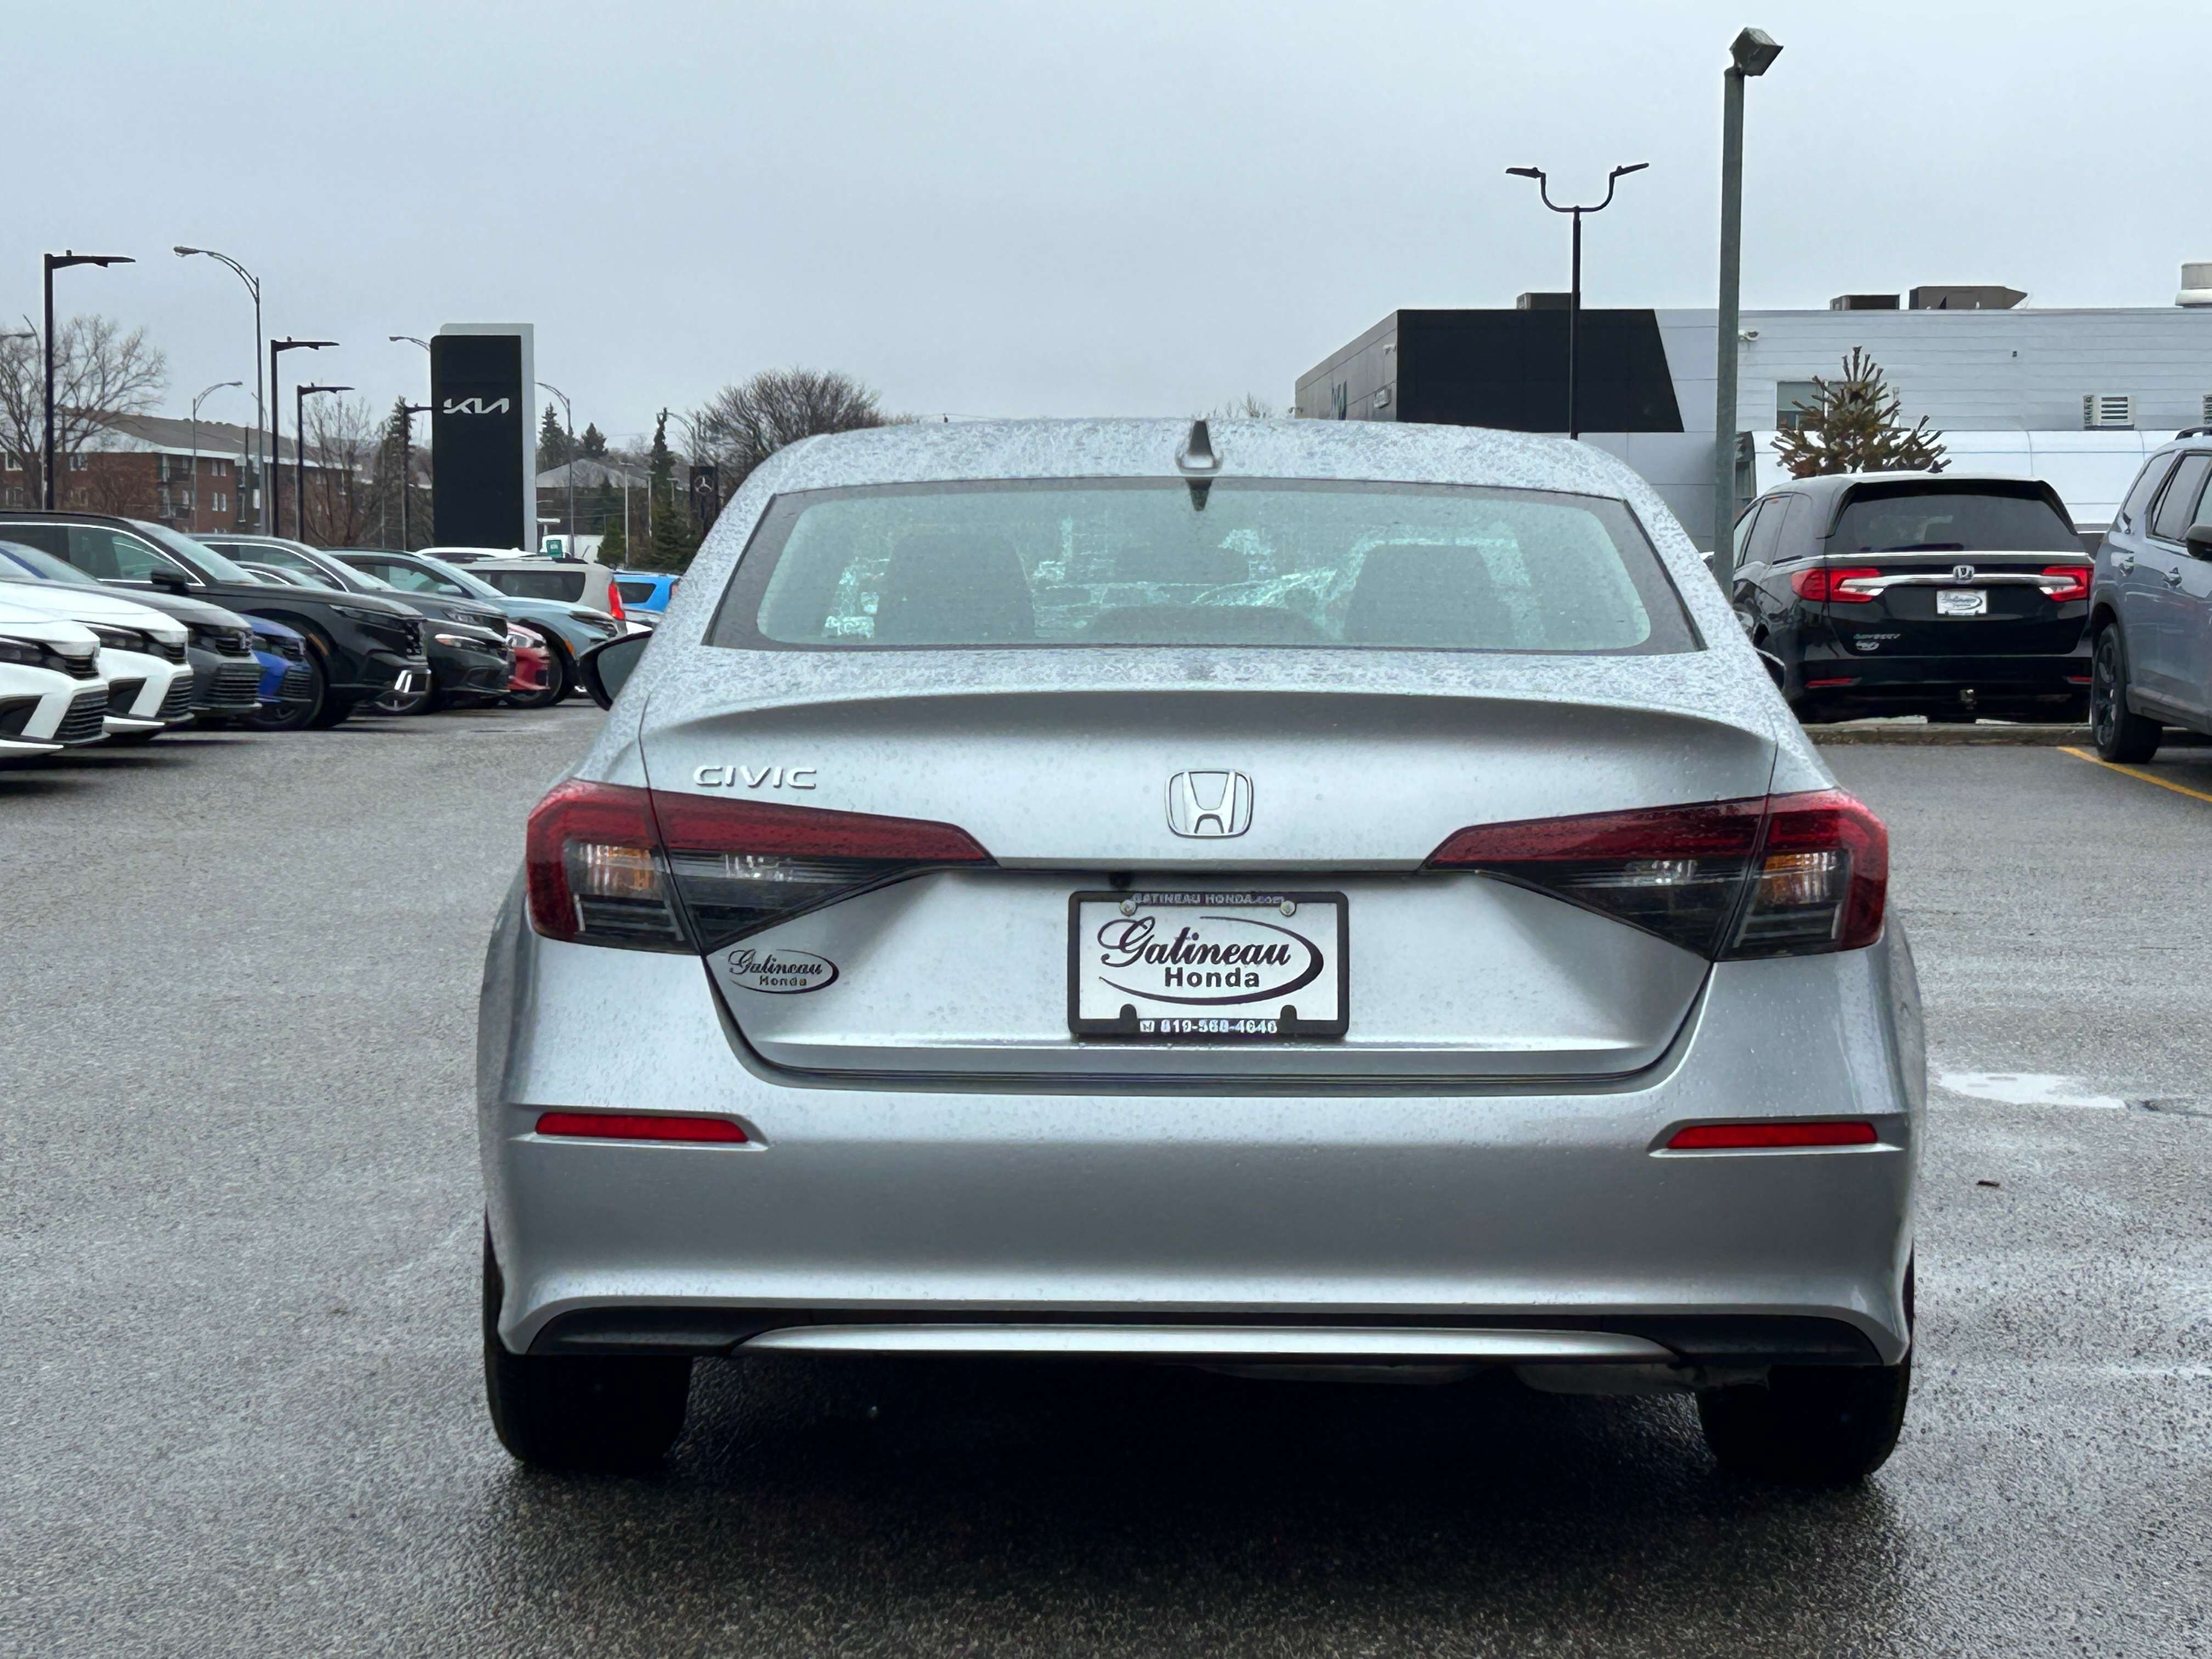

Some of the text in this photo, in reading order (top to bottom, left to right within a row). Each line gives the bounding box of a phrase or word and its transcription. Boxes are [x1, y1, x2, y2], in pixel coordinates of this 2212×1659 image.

[693, 765, 817, 789] CIVIC
[1097, 916, 1292, 968] Gatineau
[729, 949, 823, 975] Gatineau
[759, 975, 807, 986] Honda
[1164, 967, 1260, 988] Honda
